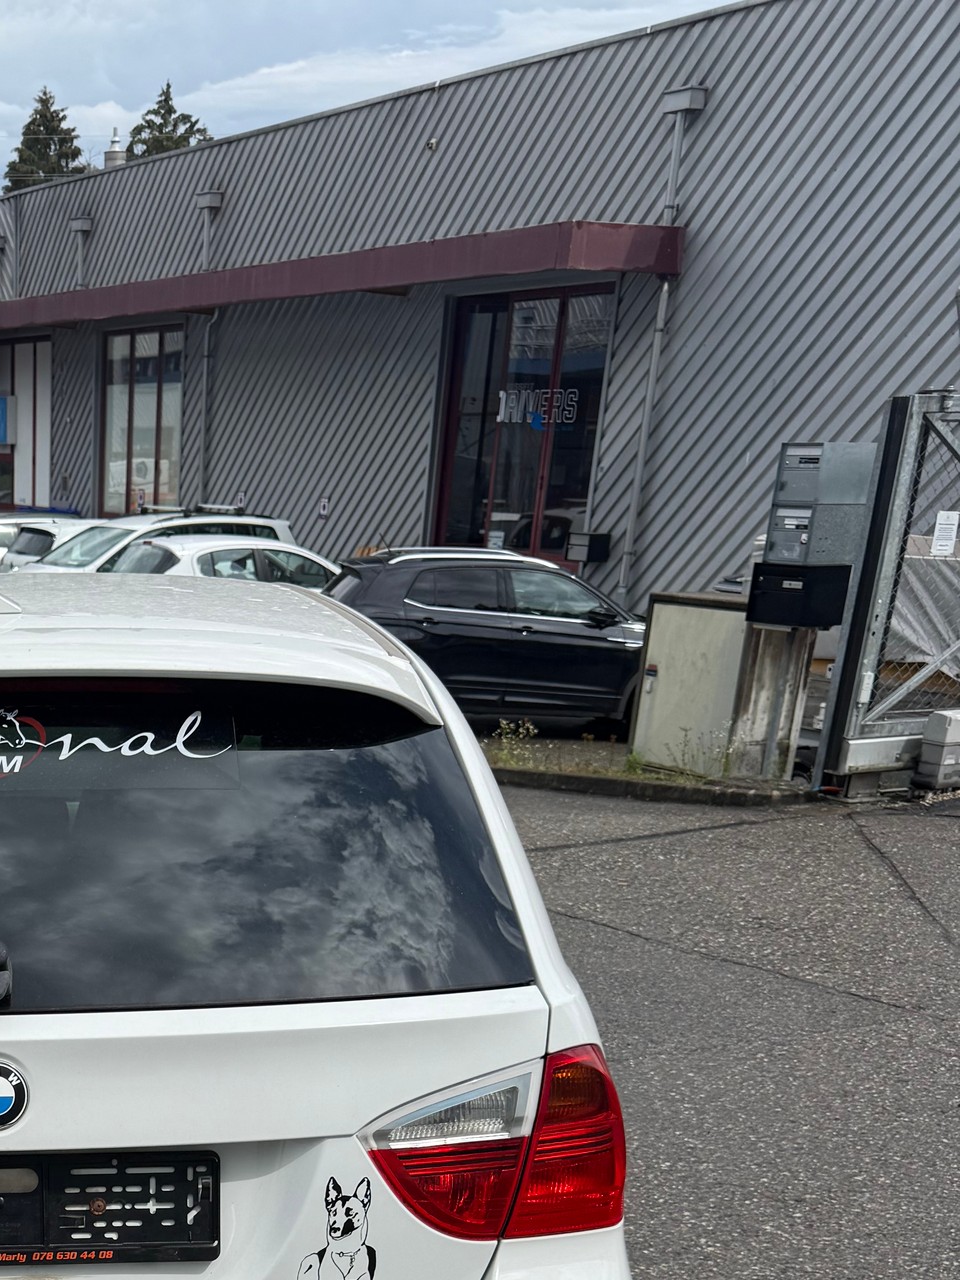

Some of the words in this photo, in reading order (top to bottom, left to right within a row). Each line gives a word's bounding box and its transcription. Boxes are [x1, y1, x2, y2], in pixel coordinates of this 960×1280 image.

[32, 1252, 54, 1261] 078
[56, 1251, 78, 1260] 630
[80, 1250, 96, 1259] 44
[98, 1250, 114, 1259] 08
